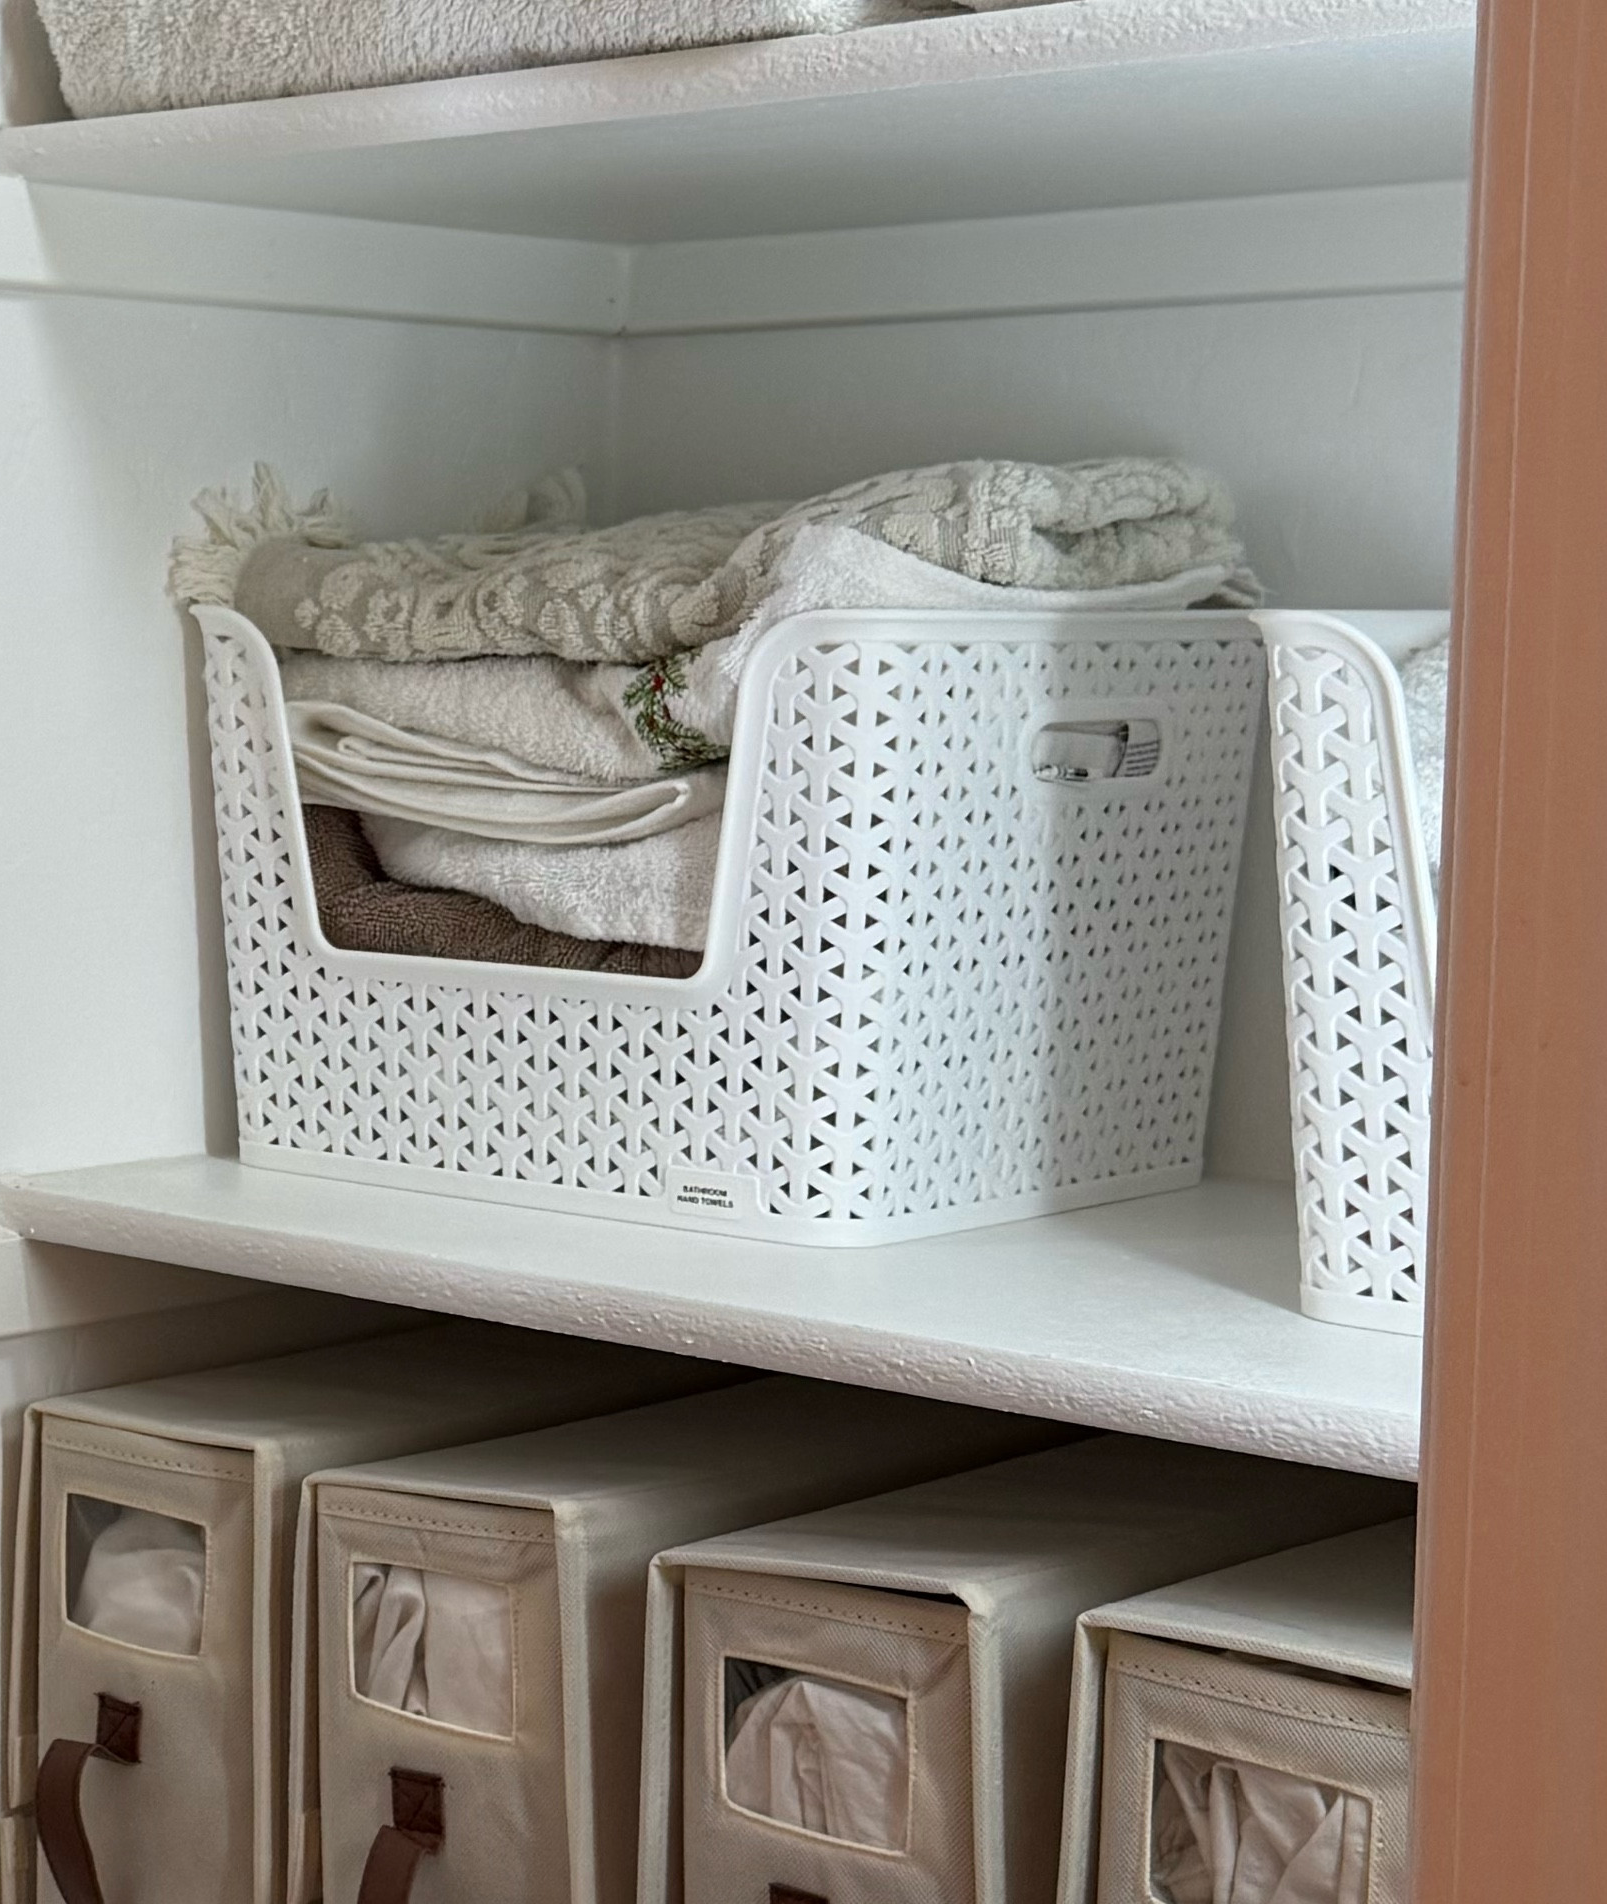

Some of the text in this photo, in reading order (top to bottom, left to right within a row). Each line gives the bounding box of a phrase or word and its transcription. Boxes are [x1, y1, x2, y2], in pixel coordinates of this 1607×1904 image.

[683, 1185, 727, 1197] BATHROOM
[676, 1195, 734, 1208] HAND TOWELS
